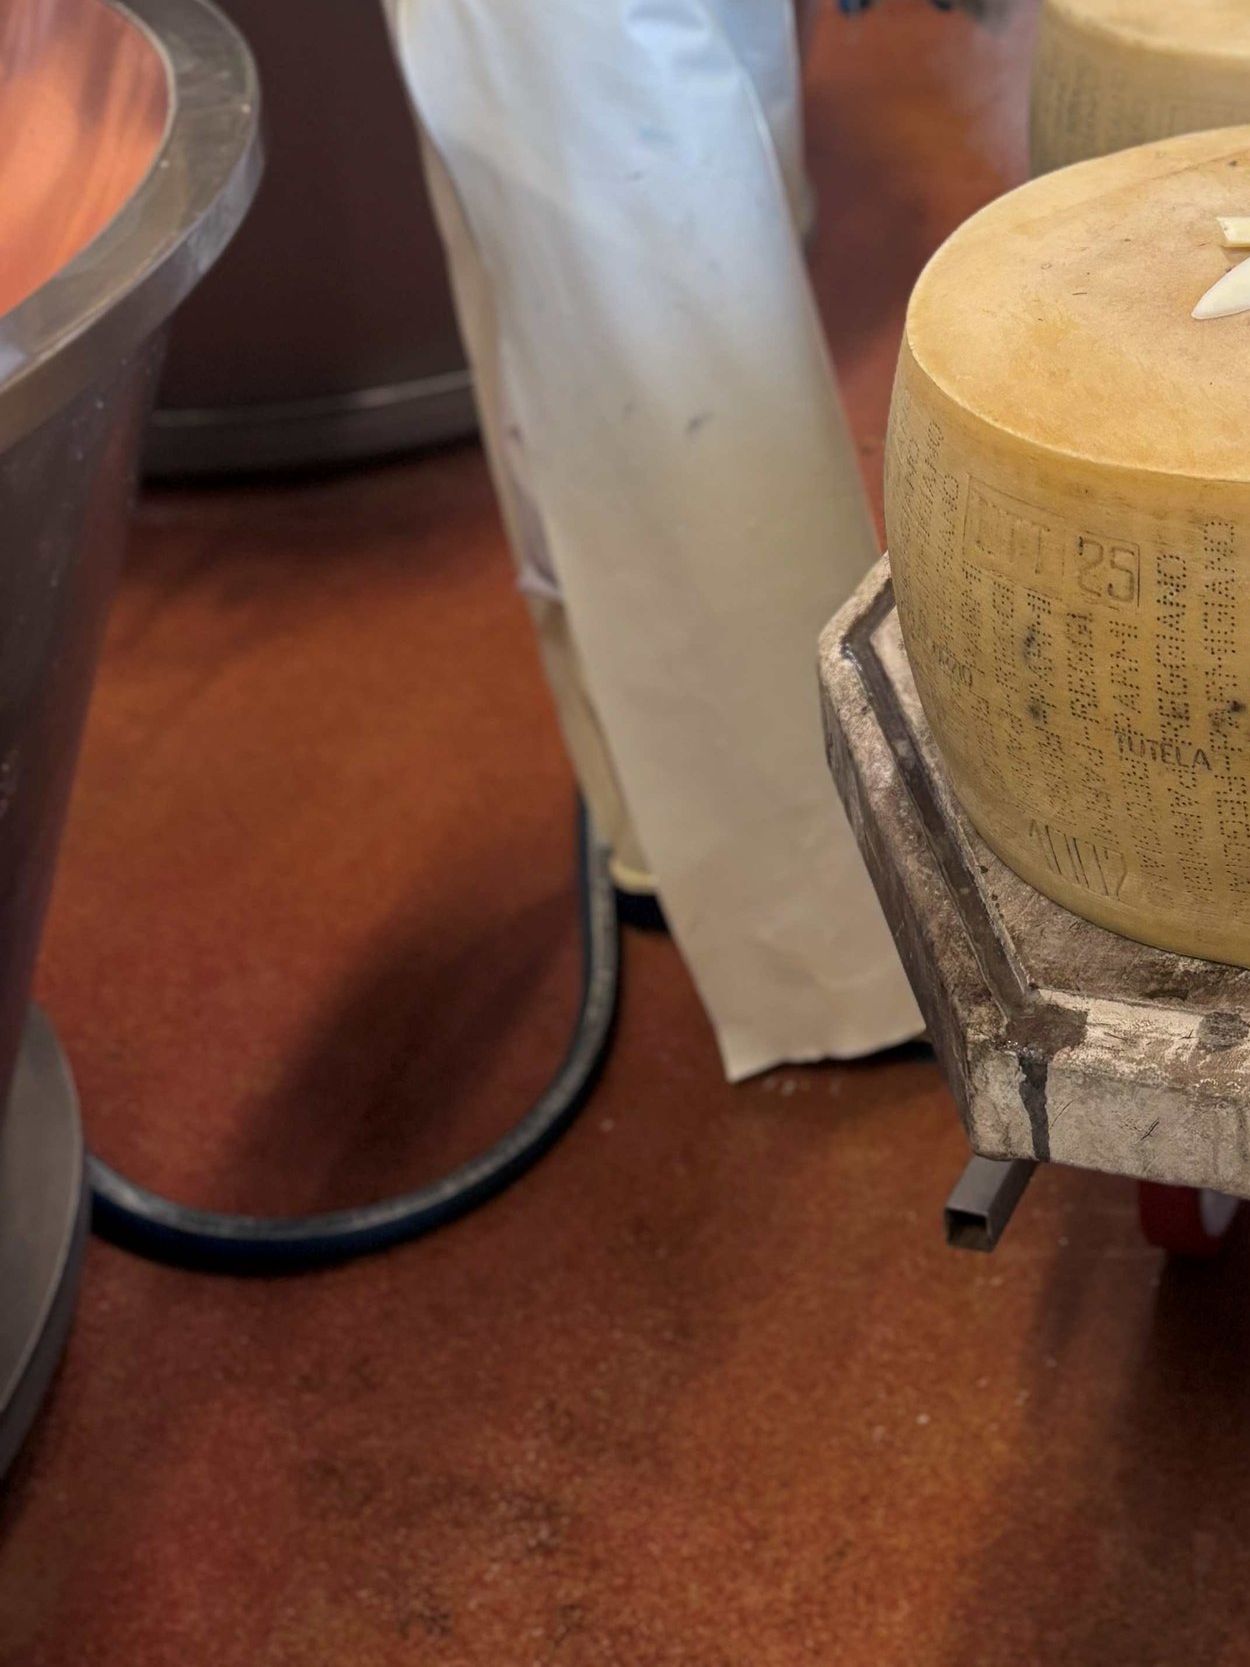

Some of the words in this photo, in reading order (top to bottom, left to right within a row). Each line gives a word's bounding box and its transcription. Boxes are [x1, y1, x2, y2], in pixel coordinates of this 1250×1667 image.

[1076, 536, 1136, 603] 25
[1156, 554, 1192, 746] REGGIANO
[1116, 727, 1212, 771] TUTELA
